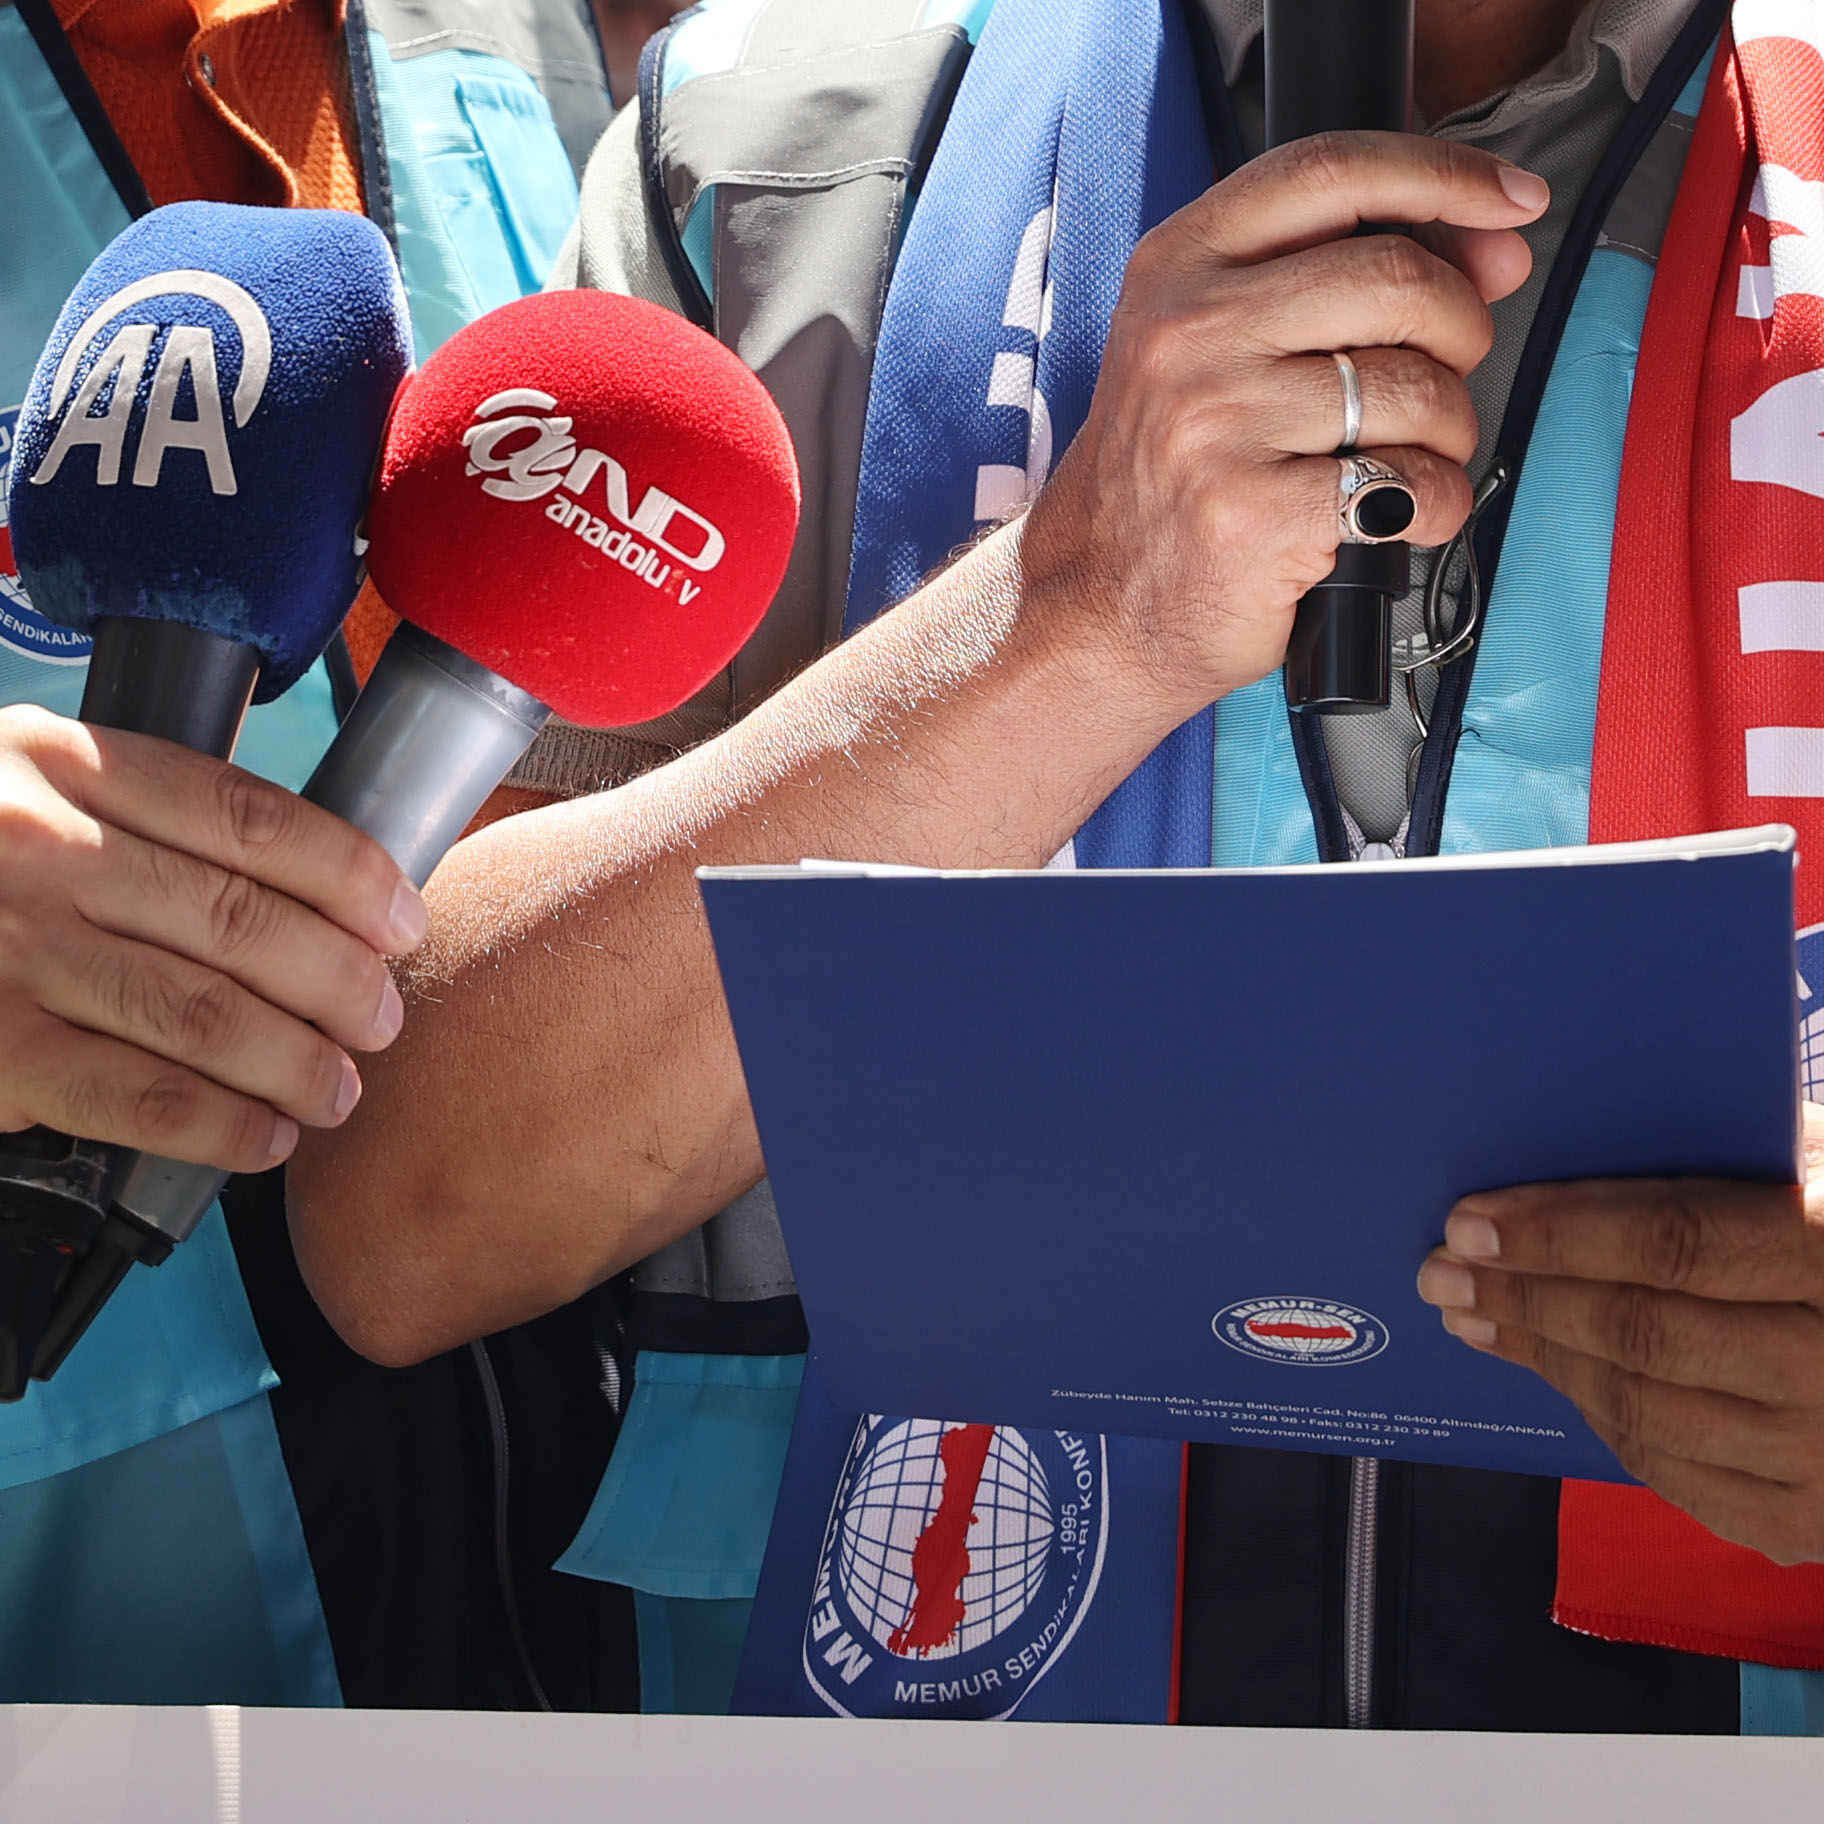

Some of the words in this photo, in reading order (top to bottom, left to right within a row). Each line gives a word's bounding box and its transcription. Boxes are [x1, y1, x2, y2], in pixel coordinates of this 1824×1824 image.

[31, 323, 240, 497] AA
[544, 492, 671, 589] anadolu
[1230, 1300, 1368, 1325] MEMUR-SEN
[1164, 1396, 1198, 1406] Mah.
[1201, 1399, 1244, 1409] Sebze
[1246, 1401, 1311, 1414] Bahçeleri
[1312, 1406, 1344, 1417] Cad.
[1167, 1407, 1192, 1417] Tel:
[1193, 1410, 1228, 1419] 0312
[1231, 1412, 1257, 1421] 230
[1309, 1418, 1343, 1429] Faks:
[1345, 1421, 1379, 1431] 0312
[1383, 1423, 1409, 1434] 230
[1230, 1425, 1397, 1446] www.memursen.org.tr
[1060, 1502, 1079, 1555] 1995
[894, 1668, 1003, 1704] MEMUR
